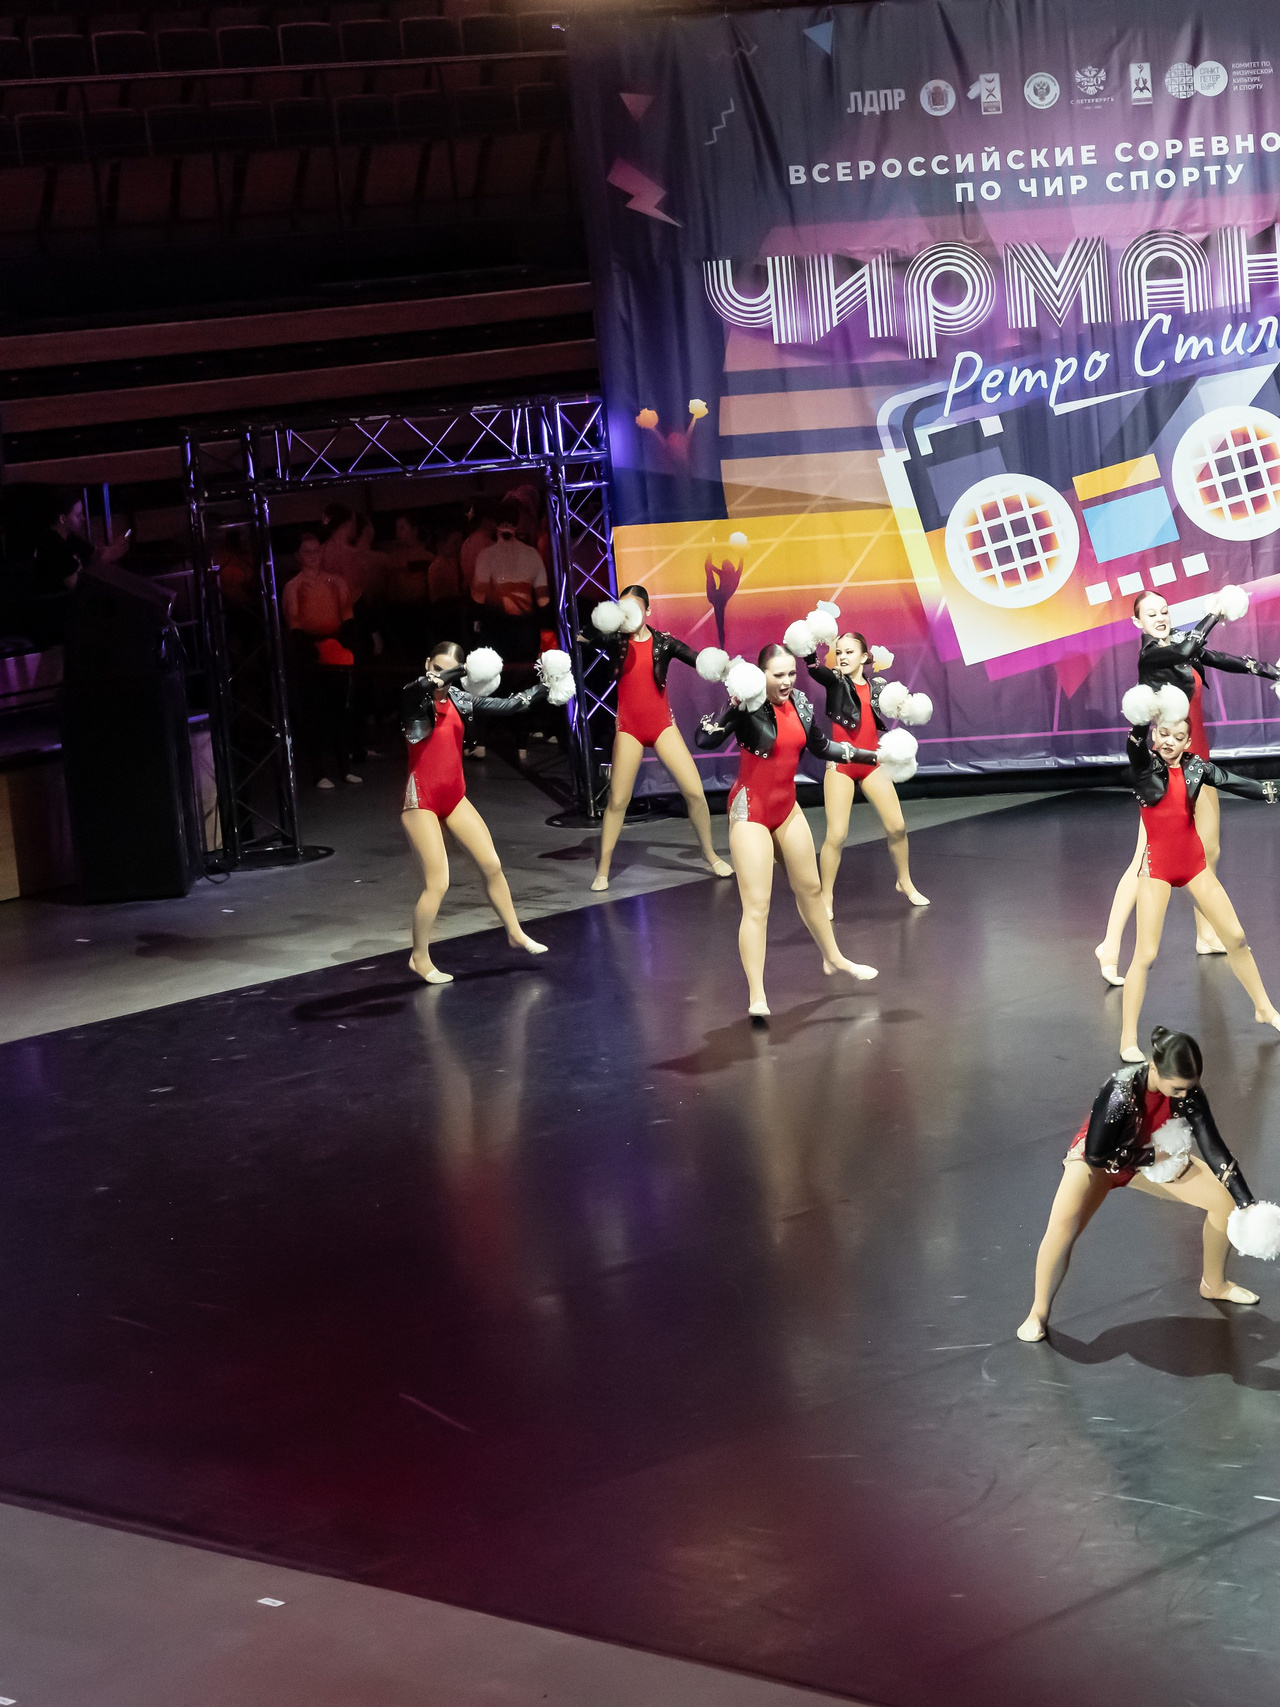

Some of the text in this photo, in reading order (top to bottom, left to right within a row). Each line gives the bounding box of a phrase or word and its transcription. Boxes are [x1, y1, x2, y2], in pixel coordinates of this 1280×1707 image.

[847, 88, 906, 116] ЛДПР
[788, 144, 1098, 185] ВСЕРОССИЙСКИЕ
[955, 163, 1245, 203] ПО ЧИР СПОРТУ
[943, 349, 1111, 418] Ретро
